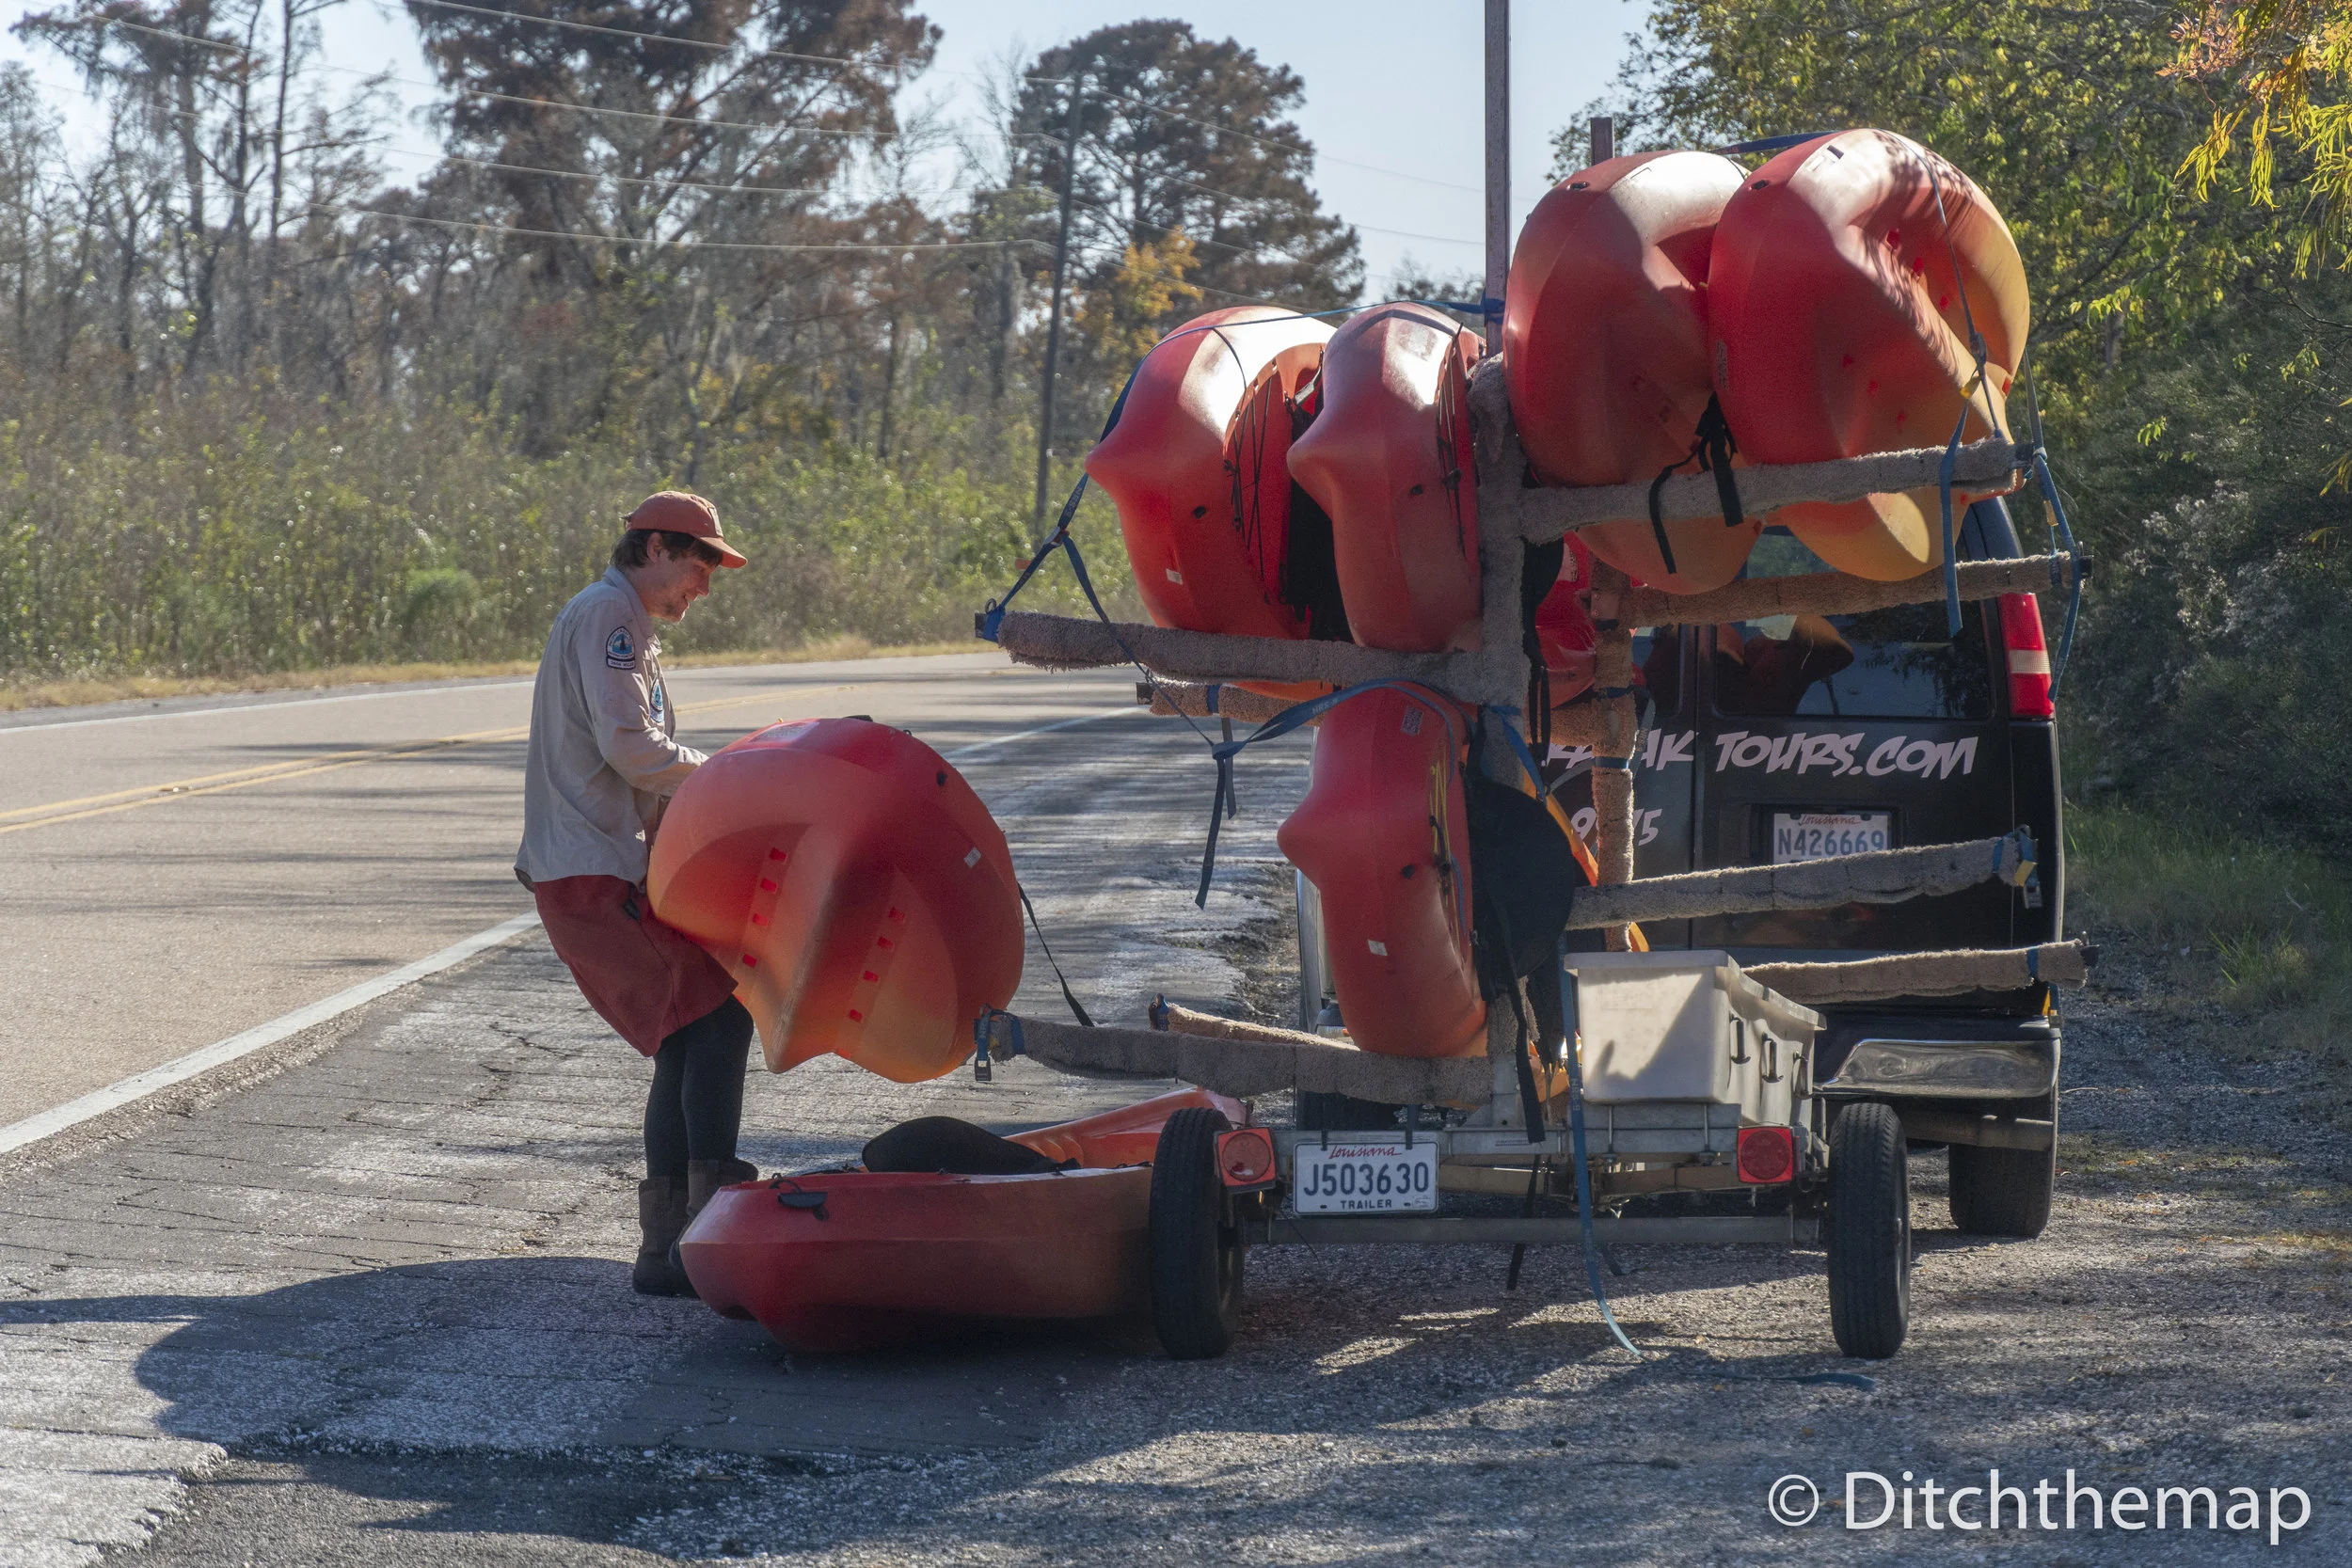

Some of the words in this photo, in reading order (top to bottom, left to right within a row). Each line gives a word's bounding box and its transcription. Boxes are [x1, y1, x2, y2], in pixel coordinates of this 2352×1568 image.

[1715, 731, 1979, 780] TOURS.COM
[1571, 807, 1662, 847] 95
[1798, 815, 1862, 827] Louisiana
[1778, 829, 1884, 856] N426669
[1328, 1145, 1402, 1159] Louisiana
[1304, 1162, 1429, 1196] J503630
[1341, 1199, 1391, 1210] TRAILER
